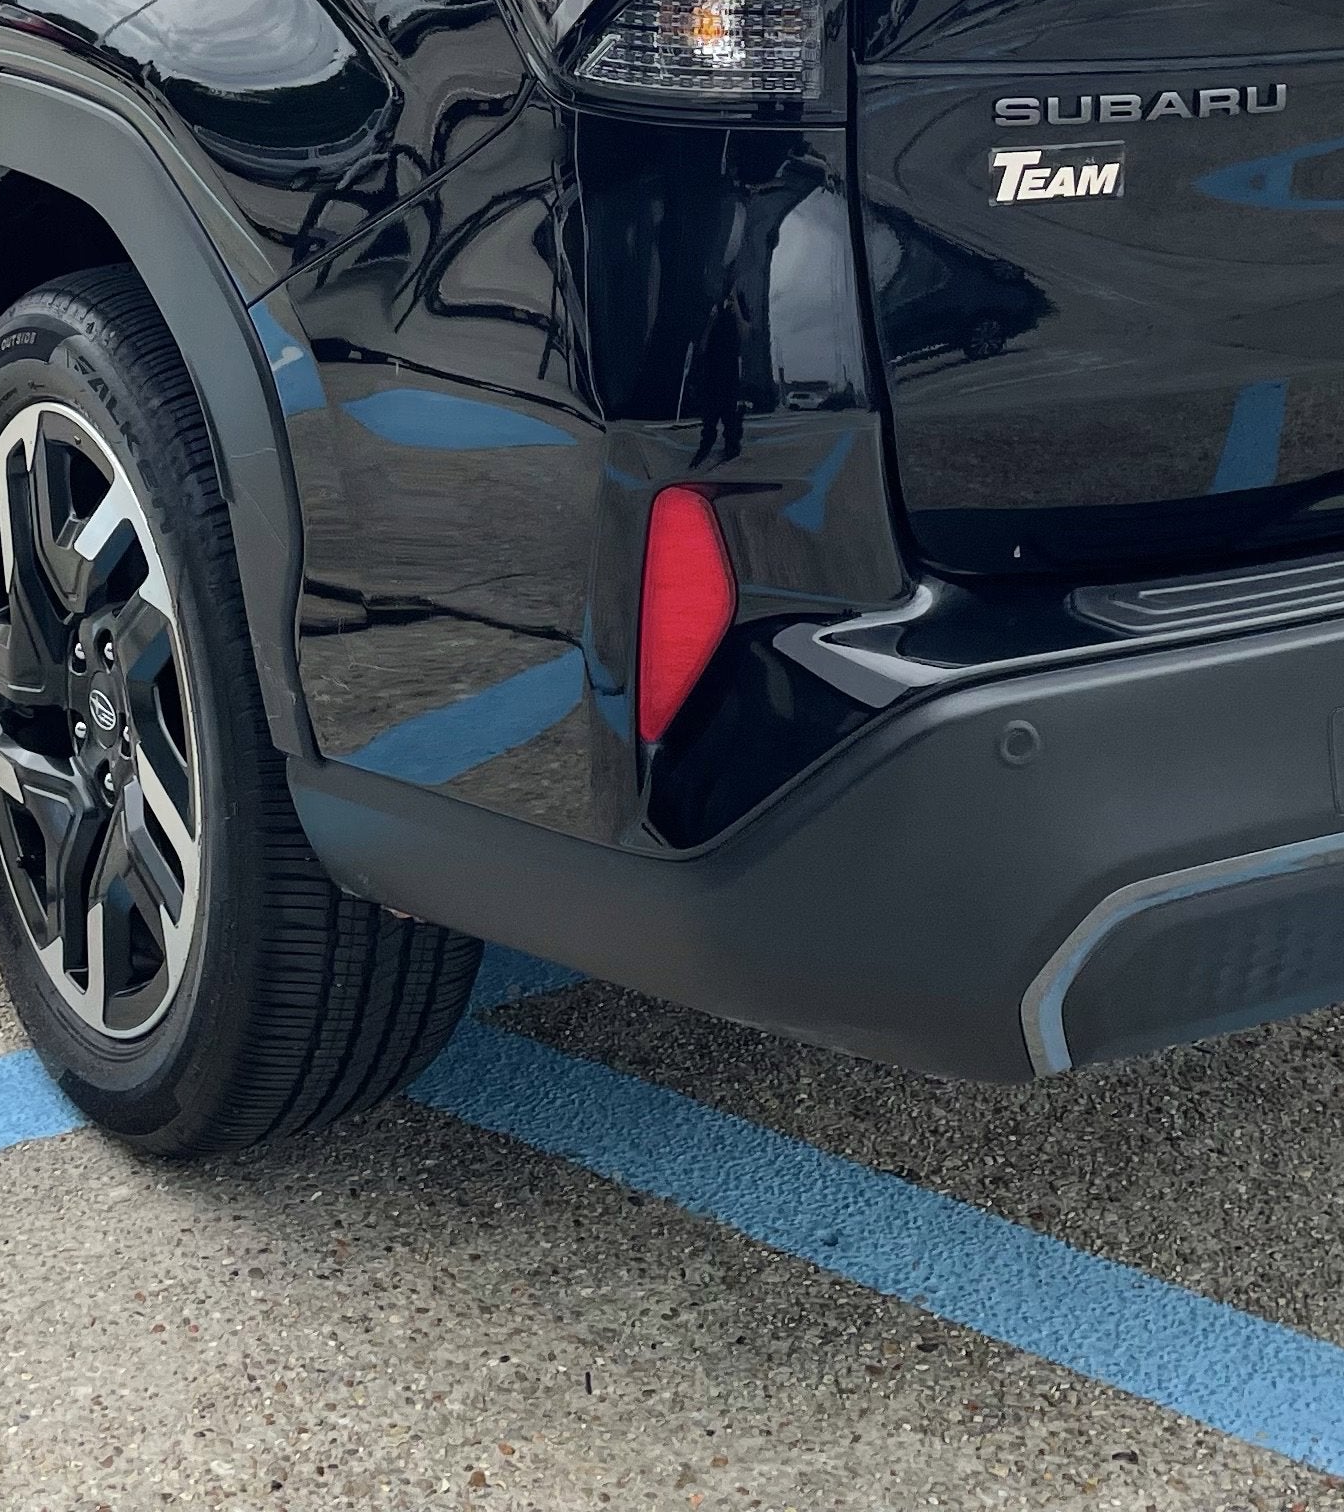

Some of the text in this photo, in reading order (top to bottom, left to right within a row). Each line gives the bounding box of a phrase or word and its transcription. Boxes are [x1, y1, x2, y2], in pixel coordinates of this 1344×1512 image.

[994, 83, 1288, 127] SUBARU
[992, 150, 1121, 202] TEAM
[0, 331, 38, 351] OUTSIDE
